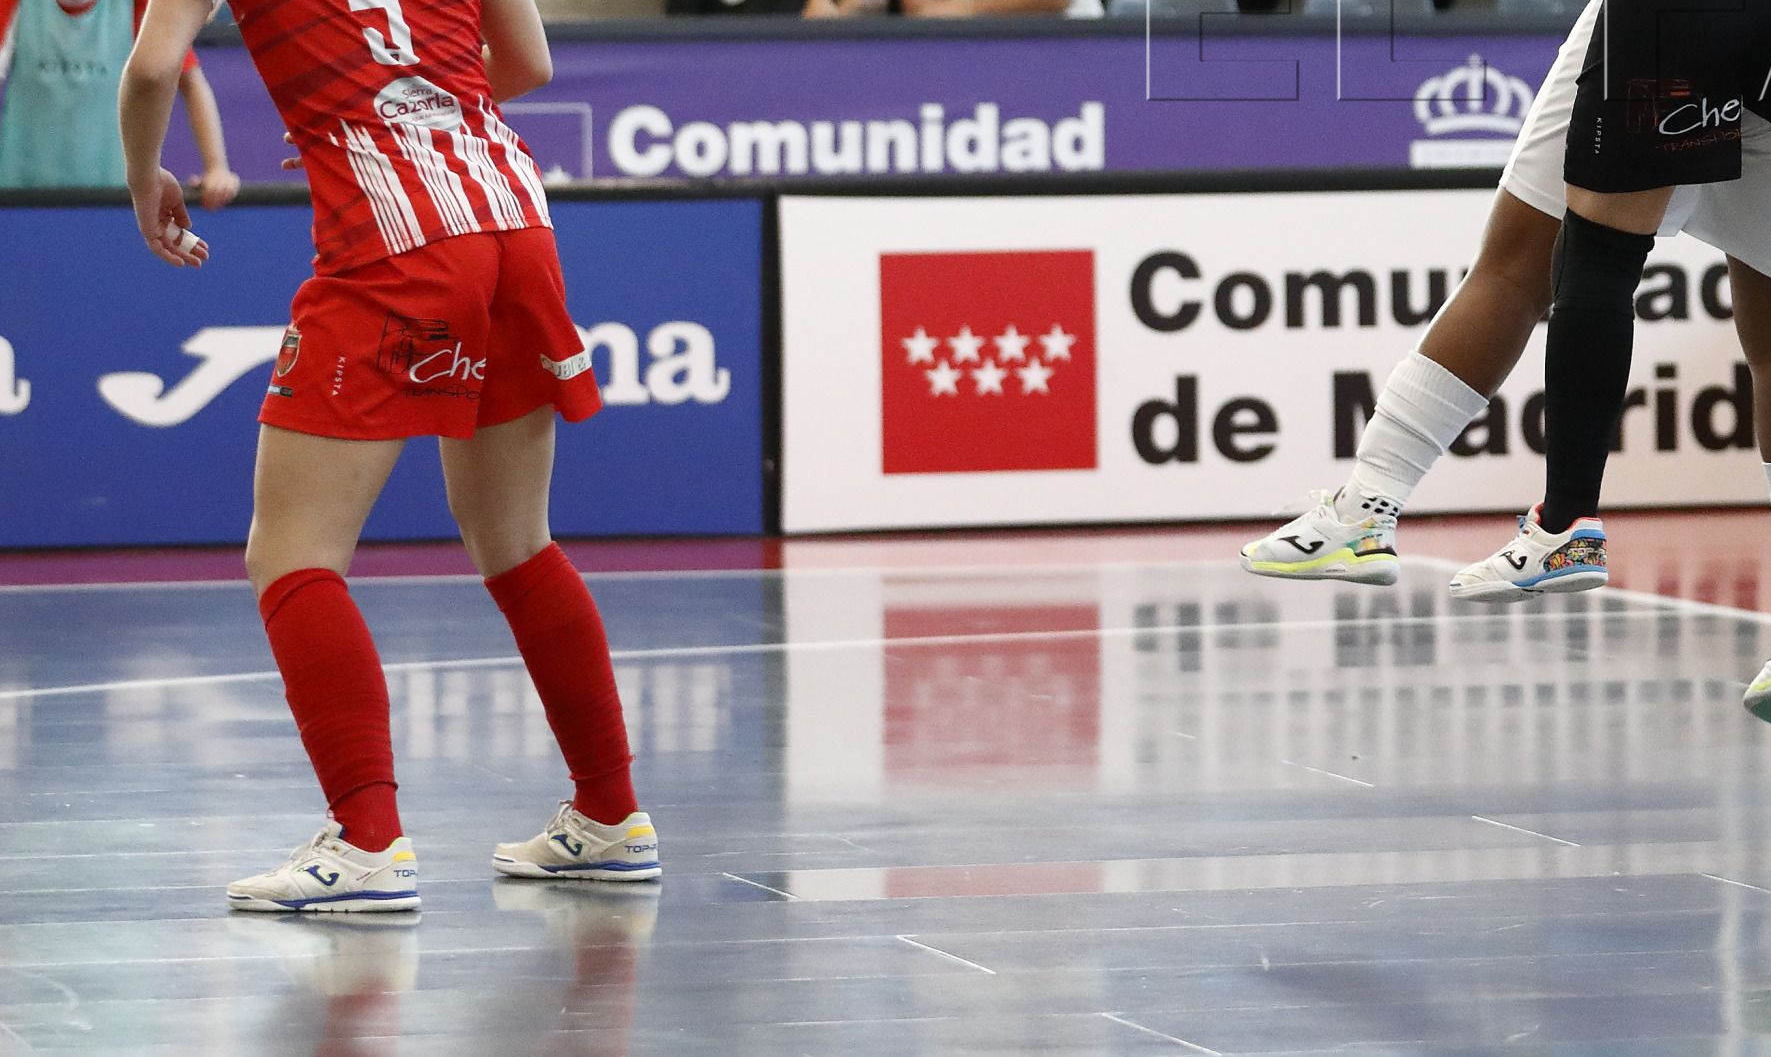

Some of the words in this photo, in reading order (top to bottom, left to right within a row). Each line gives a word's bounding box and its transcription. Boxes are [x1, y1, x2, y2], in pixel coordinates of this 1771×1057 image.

[379, 92, 455, 119] Cazorla
[608, 102, 1105, 176] Comunidad
[331, 355, 346, 396] KIPSTA
[1131, 374, 1279, 465] de
